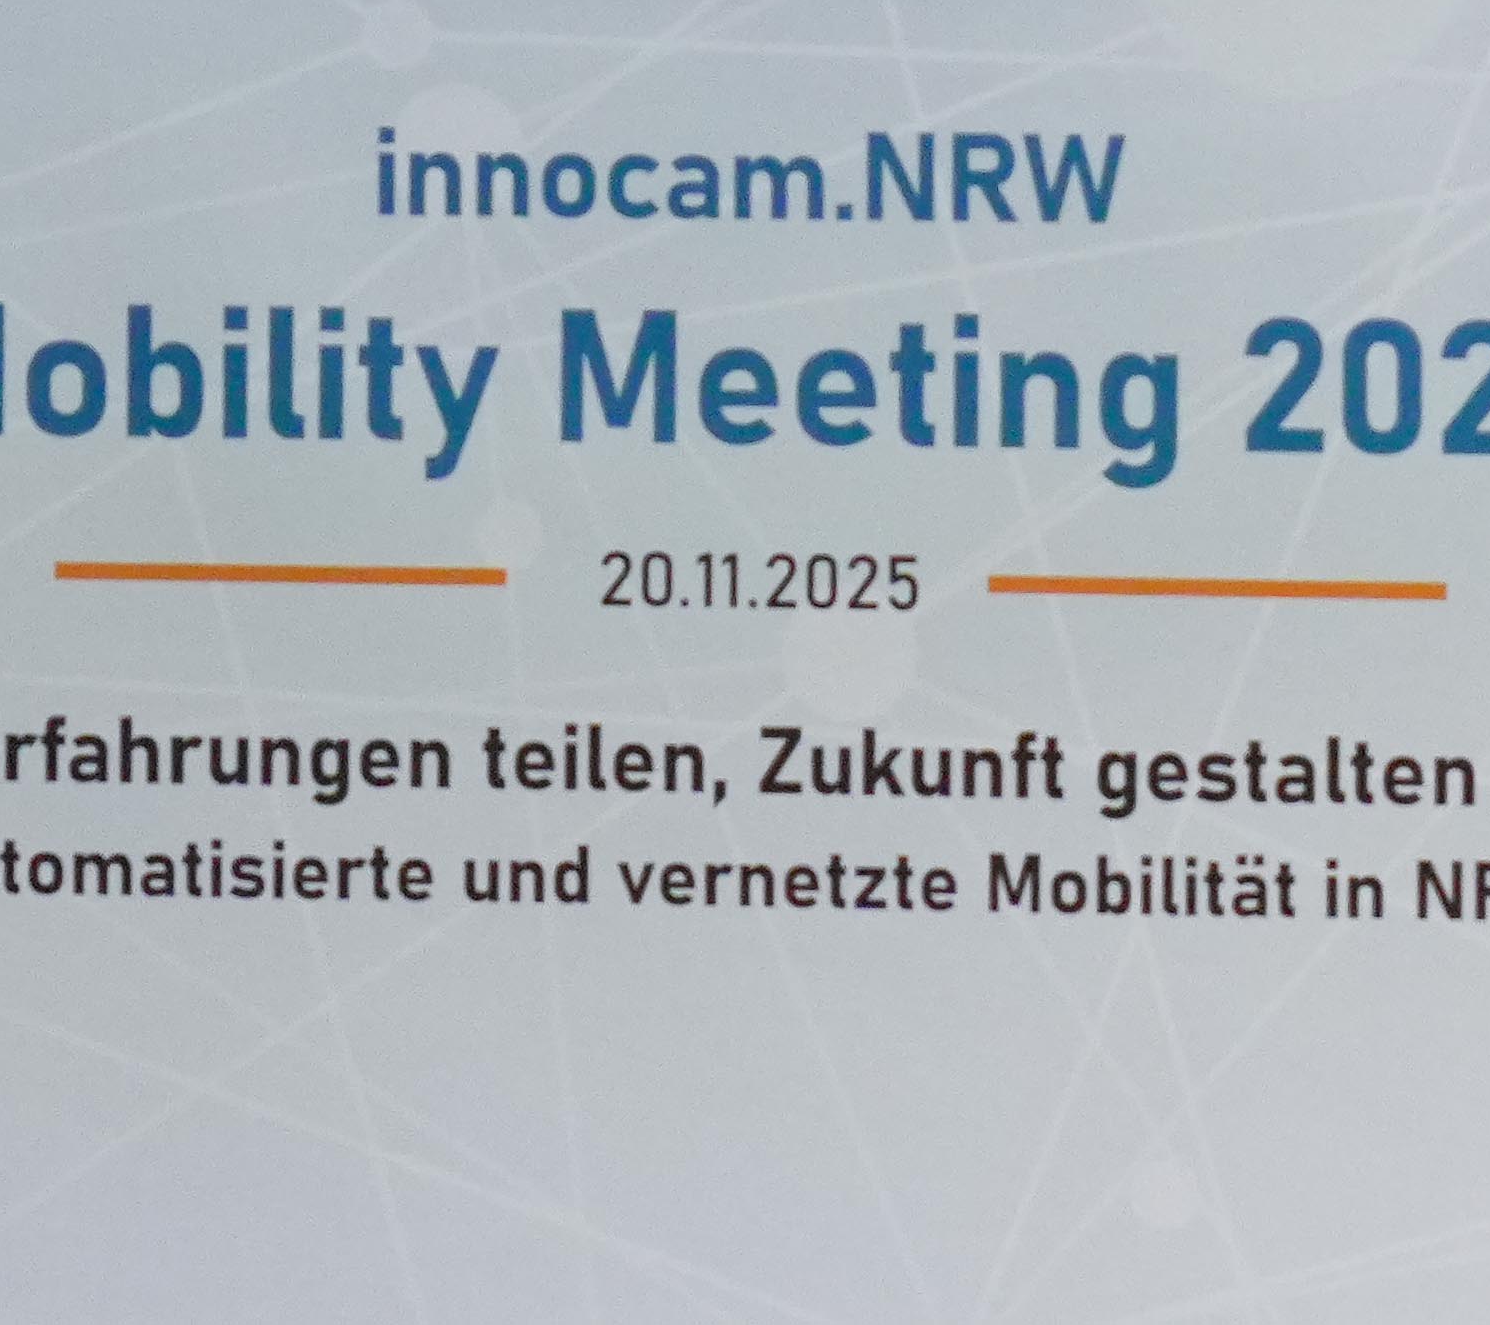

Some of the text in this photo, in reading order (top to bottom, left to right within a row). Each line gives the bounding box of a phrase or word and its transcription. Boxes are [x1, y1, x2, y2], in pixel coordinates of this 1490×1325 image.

[379, 127, 1124, 223] innocam.NRW
[561, 310, 1177, 488] Meeting
[602, 551, 918, 610] 20.11.2025
[484, 724, 726, 804] teilen,
[760, 727, 1063, 799] Zukunft
[1098, 737, 1474, 819] gestalten
[465, 846, 588, 903] und
[619, 855, 956, 911] vernetzte
[989, 854, 1294, 917] Mobilität
[1327, 860, 1383, 918] in
